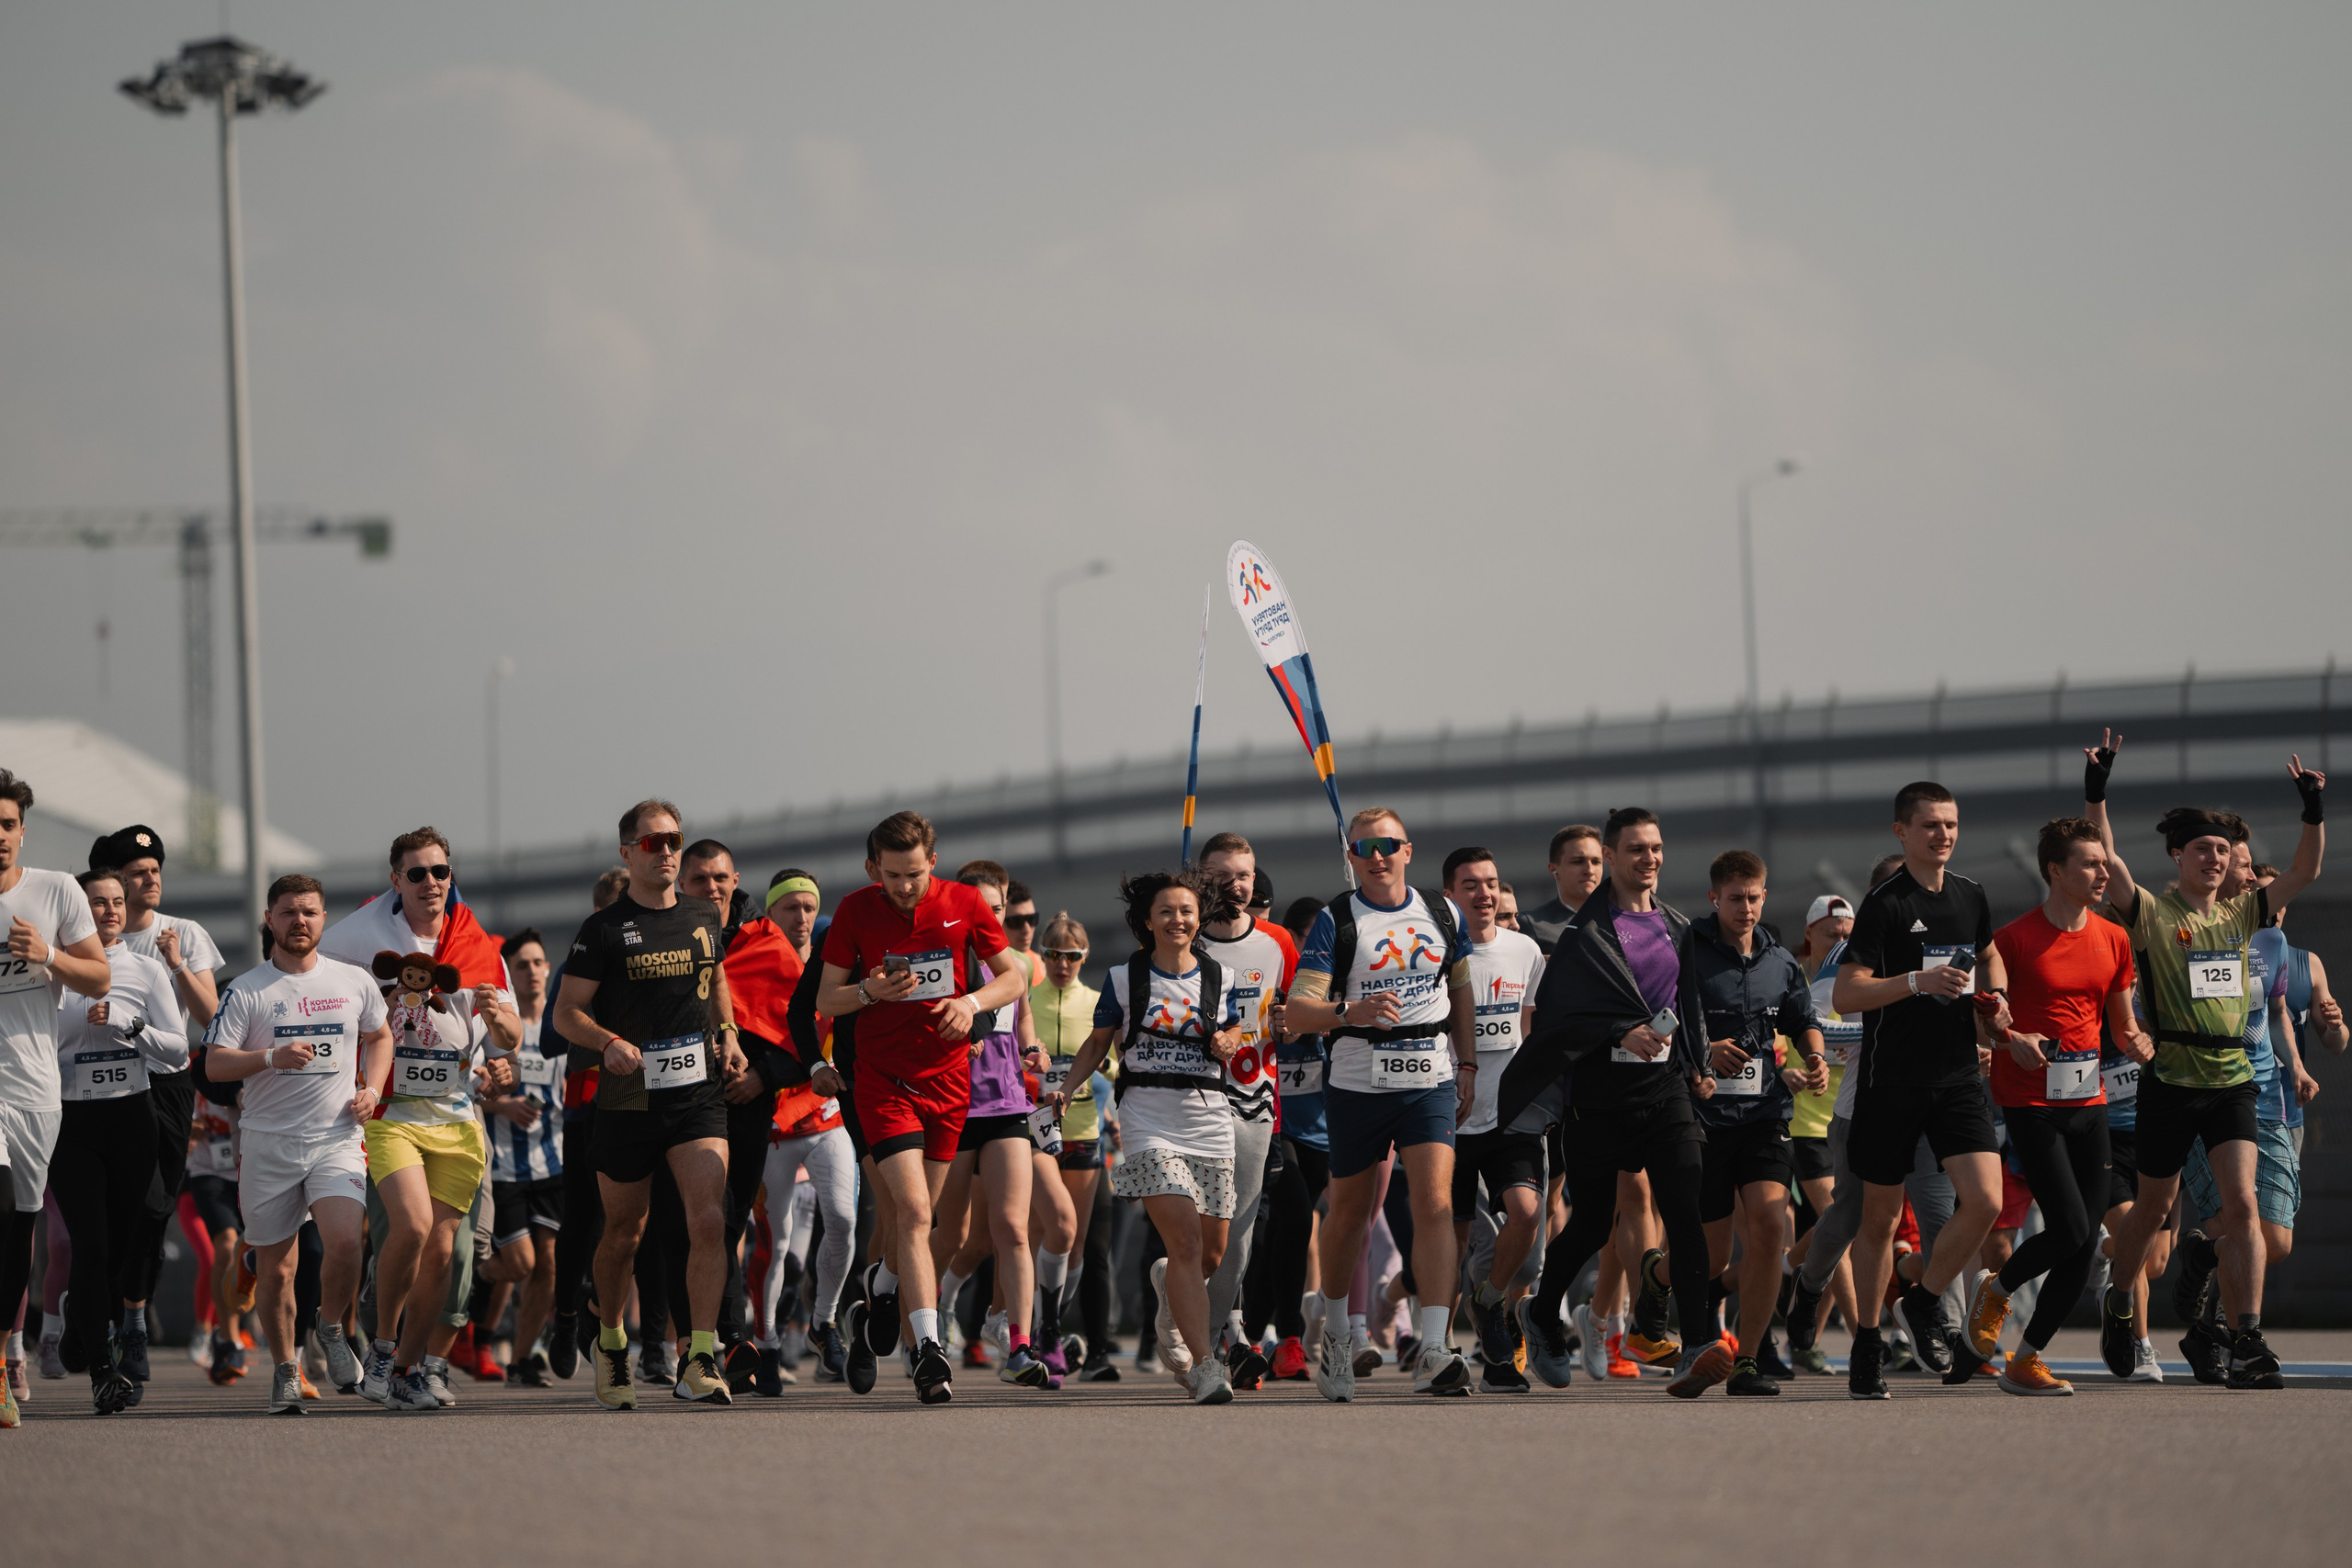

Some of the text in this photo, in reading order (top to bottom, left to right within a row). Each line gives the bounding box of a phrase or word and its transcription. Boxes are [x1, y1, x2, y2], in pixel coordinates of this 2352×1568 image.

[625, 936, 643, 945] STAR
[626, 949, 691, 968] MOSCOW
[627, 962, 694, 980] LUZHNIKI
[2202, 968, 2232, 982] 125
[1502, 982, 1525, 990] Первые
[310, 998, 349, 1006] КОМАНДА
[311, 1003, 343, 1012] КАЗАНИ
[657, 1053, 695, 1073] 758
[1137, 1051, 1172, 1061] ДРУГ
[1380, 1058, 1431, 1073] 1866
[92, 1067, 127, 1084] 515
[406, 1066, 447, 1082] 505
[1046, 1070, 1069, 1083] 83
[2075, 1069, 2082, 1083] 1
[2113, 1069, 2141, 1086] 118
